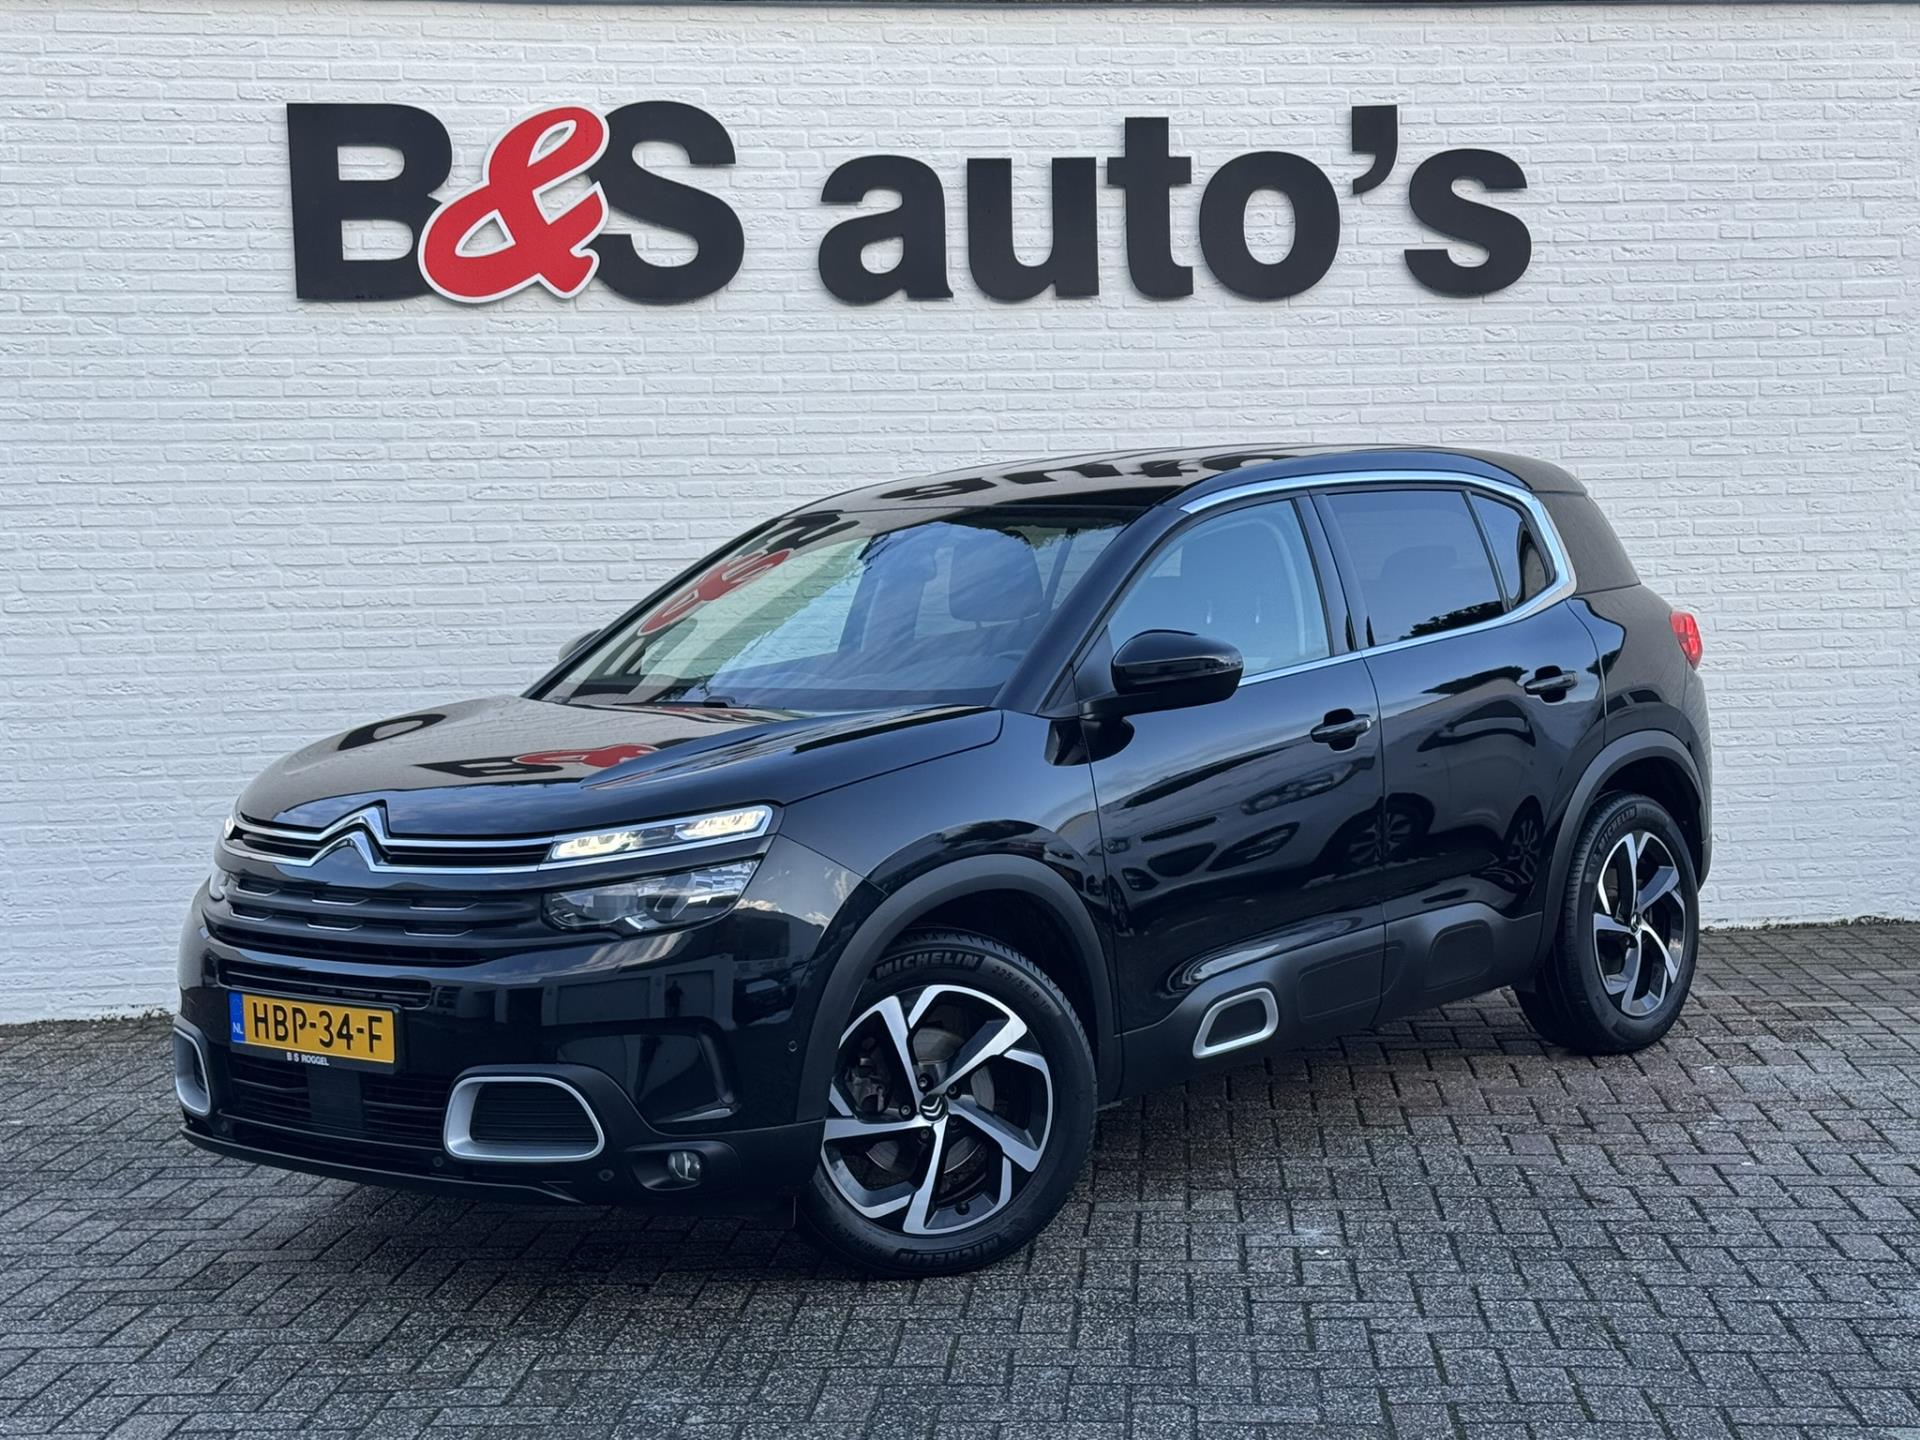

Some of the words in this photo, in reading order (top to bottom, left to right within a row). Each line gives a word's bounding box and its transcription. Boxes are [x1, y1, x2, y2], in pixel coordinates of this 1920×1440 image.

[287, 101, 744, 305] B&S
[818, 104, 1532, 303] auto's
[875, 951, 980, 978] MICHELIN
[232, 1021, 244, 1035] NL
[252, 1001, 383, 1053] HBP-34-F
[301, 1054, 330, 1066] ROGGEL
